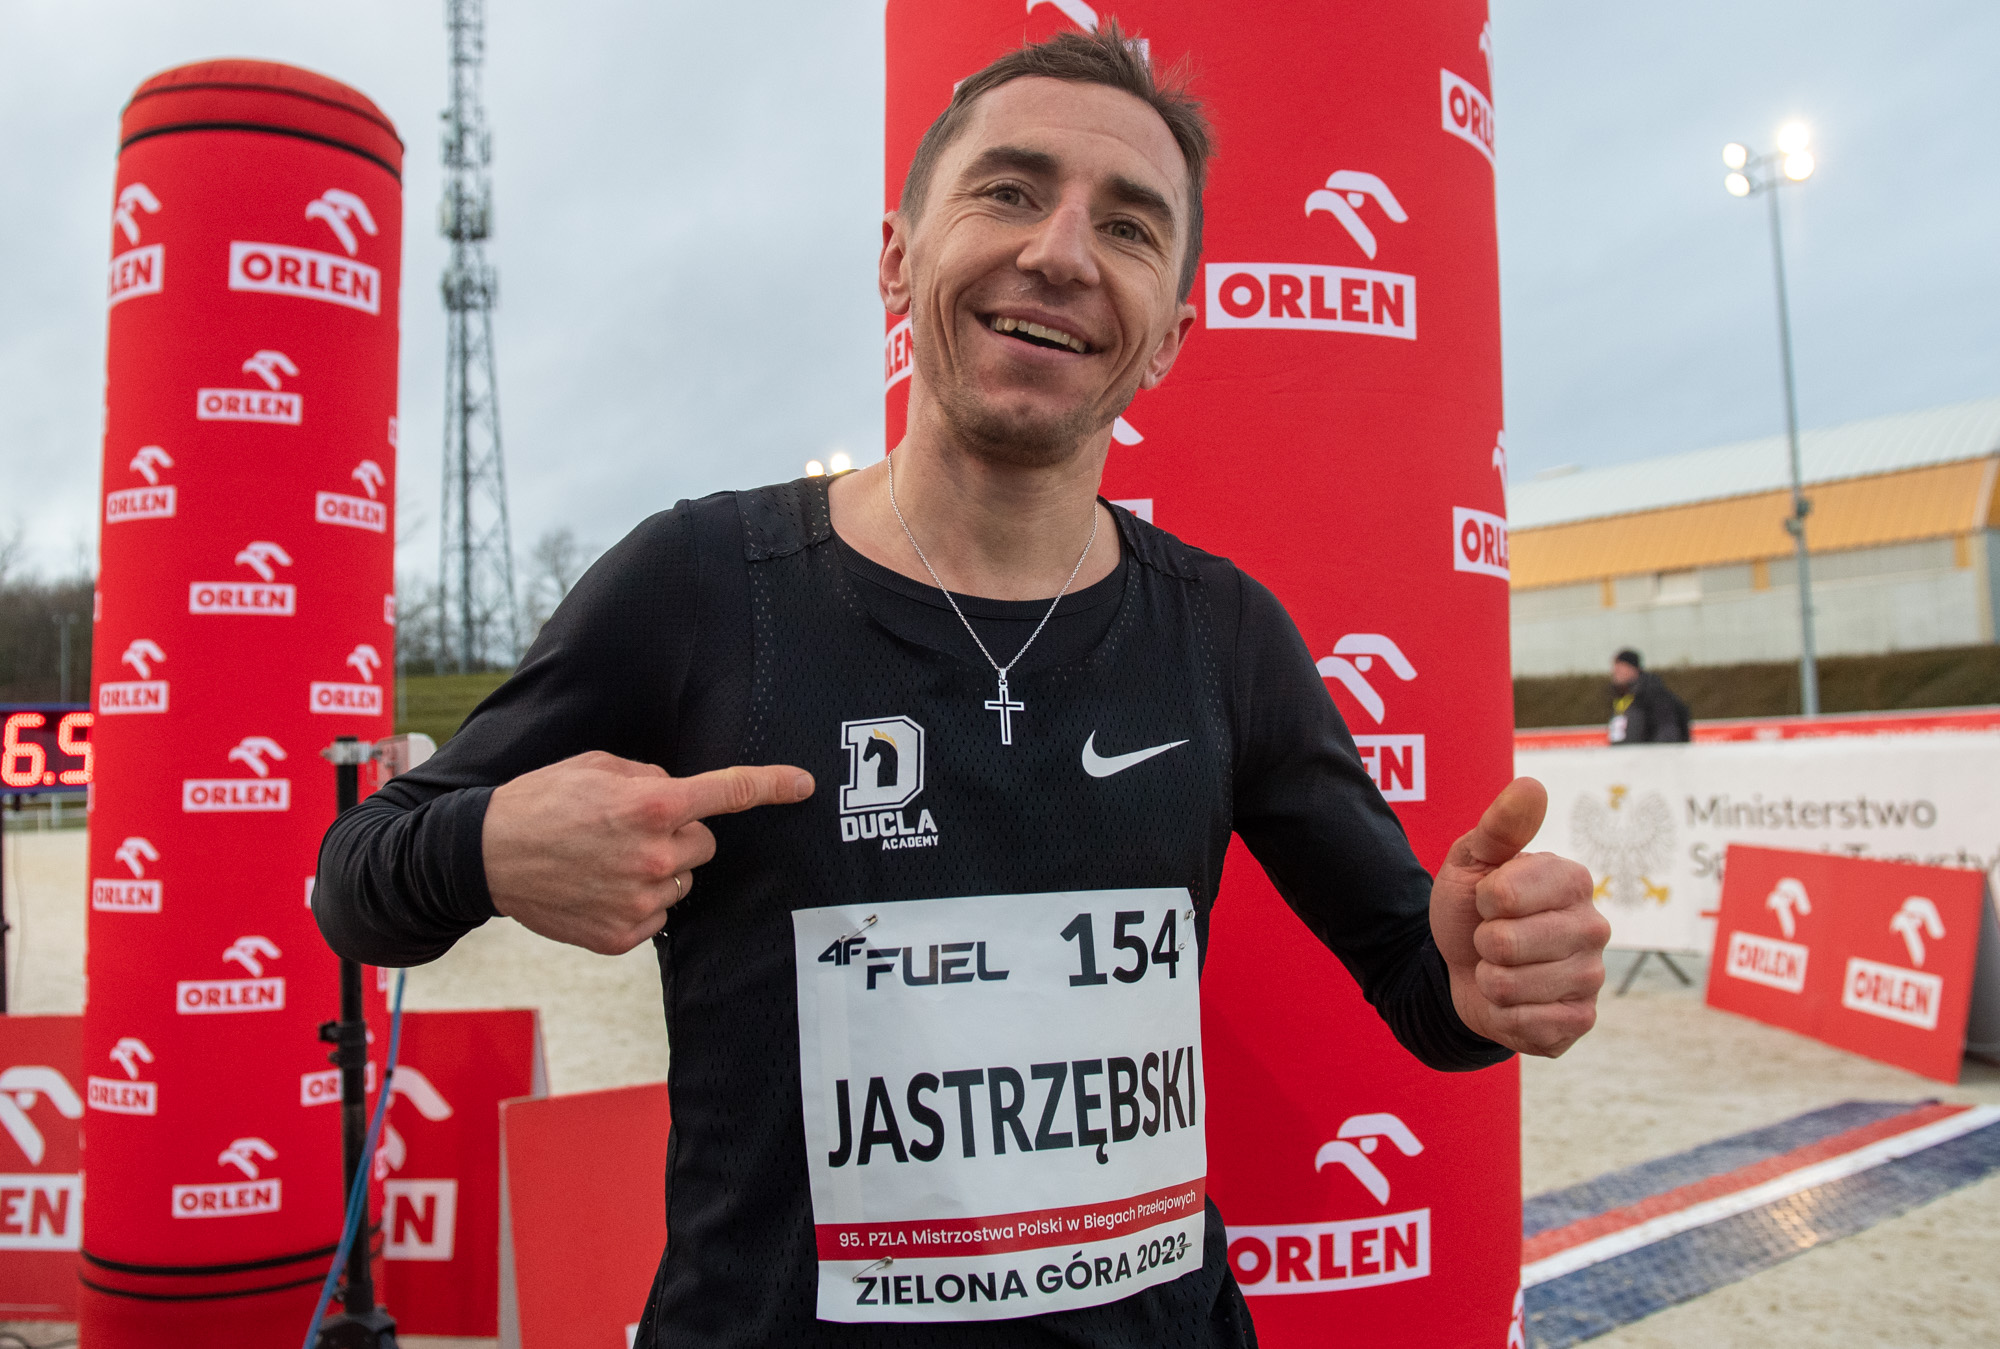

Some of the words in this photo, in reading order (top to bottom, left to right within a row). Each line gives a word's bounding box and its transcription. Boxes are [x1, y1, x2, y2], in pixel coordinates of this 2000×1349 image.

[110, 255, 153, 296] LEN
[241, 253, 372, 304] ORLEN
[1218, 272, 1405, 329] ORLEN
[204, 395, 293, 417] ORLEN
[109, 493, 167, 515] ORLEN
[322, 501, 380, 524] ORLEN
[196, 588, 286, 608] ORLEN
[101, 688, 159, 706] ORLEN
[319, 690, 378, 708] ORLEN
[190, 785, 281, 805] ORLEN
[1686, 793, 1937, 829] Ministerstwo
[840, 809, 938, 842] DUCLA
[881, 835, 939, 850] ACADEMY
[95, 886, 153, 905] ORLEN
[1060, 909, 1179, 987] 154
[1736, 944, 1797, 979] ORLEN
[867, 941, 1010, 990] FUEL
[184, 985, 275, 1007] ORLEN
[1855, 971, 1931, 1015] ORLEN
[89, 1085, 148, 1107] ORLEN
[828, 1046, 1196, 1168] JASTRZĘBSKI
[179, 1187, 271, 1211] ORLEN
[839, 1232, 865, 1247] 95.
[868, 1231, 908, 1247] PZLA
[912, 1226, 1014, 1245] Mistrzostwa
[1018, 1217, 1063, 1237] Polski
[1067, 1218, 1080, 1231] w
[1084, 1207, 1136, 1230] Biegach
[1137, 1189, 1196, 1218] Przełajowych
[856, 1269, 1029, 1305] ZIELONA
[1036, 1250, 1132, 1294] GÓRA
[1137, 1231, 1187, 1274] 2023
[1227, 1222, 1418, 1286] ORLEN
